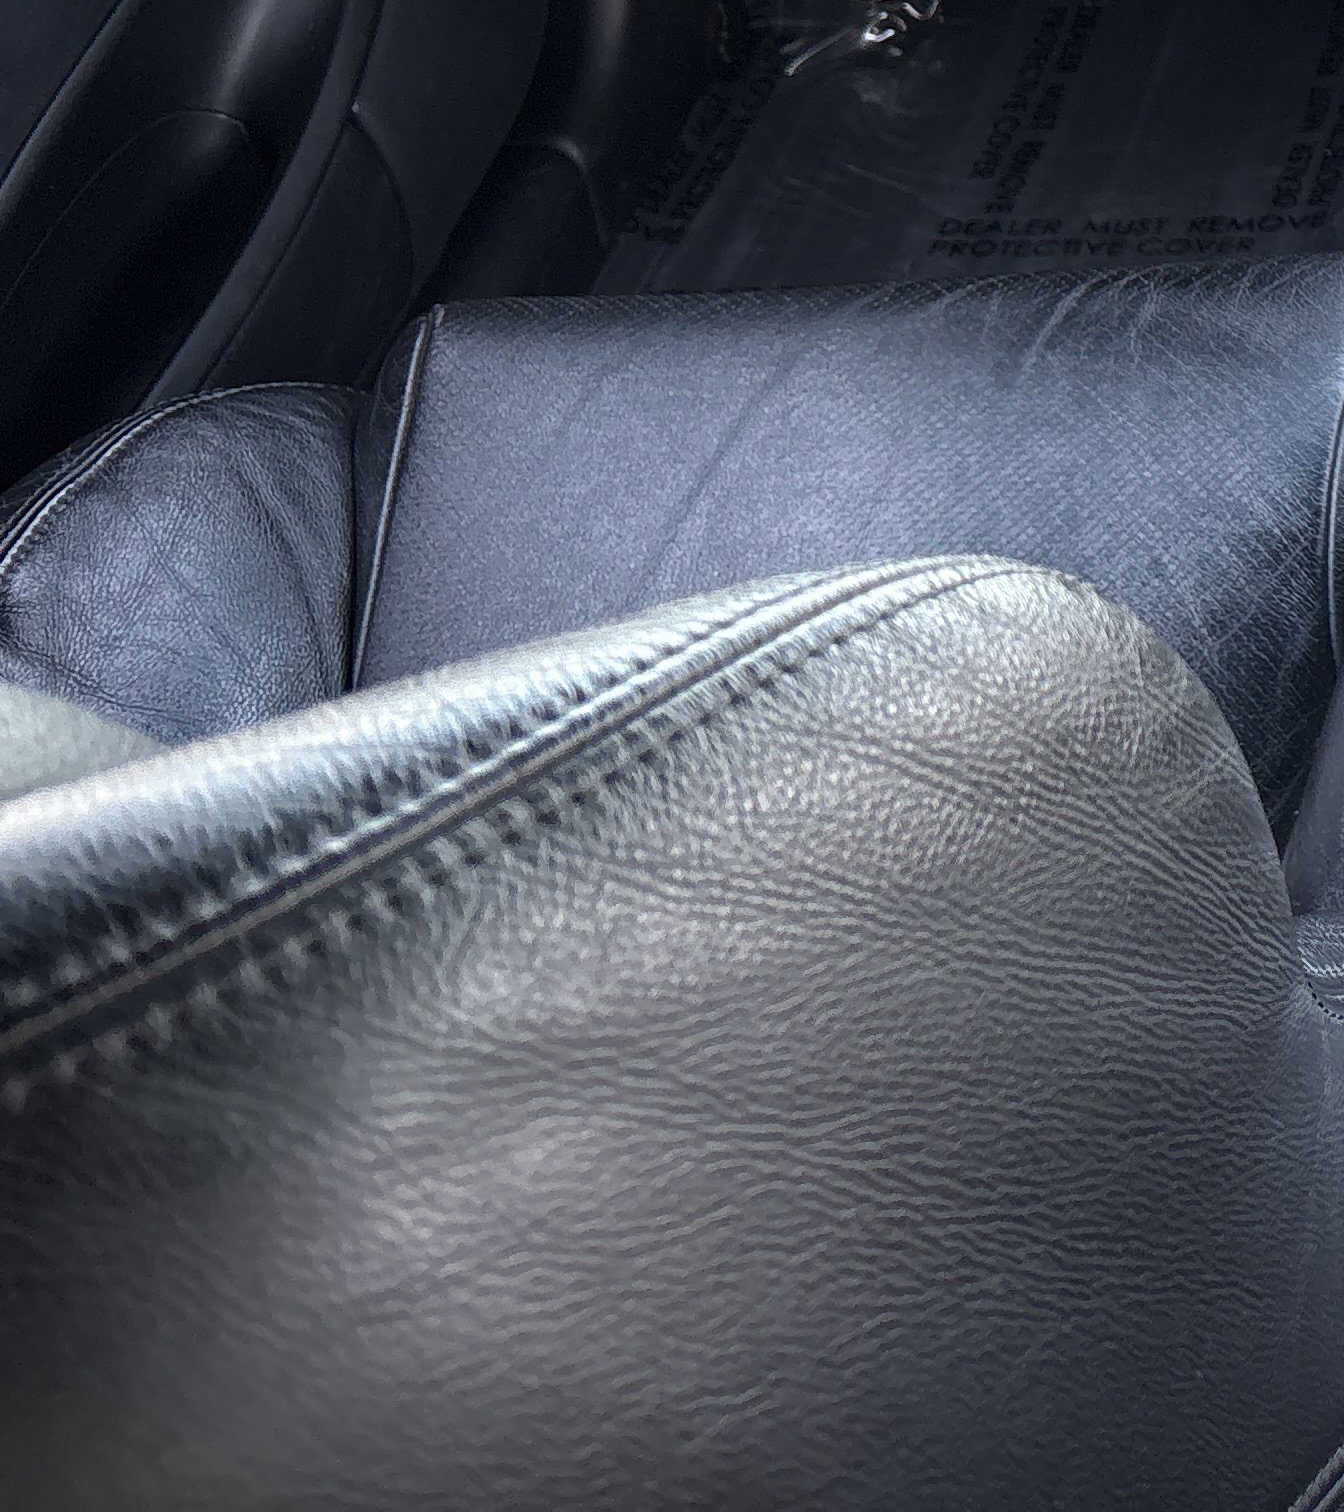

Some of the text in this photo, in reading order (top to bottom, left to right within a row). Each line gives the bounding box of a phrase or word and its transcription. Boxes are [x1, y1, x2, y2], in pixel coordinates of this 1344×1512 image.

[937, 209, 1330, 237] DEALER MUST REMOVE
[926, 235, 1258, 259] PROTECTIVE COVER
